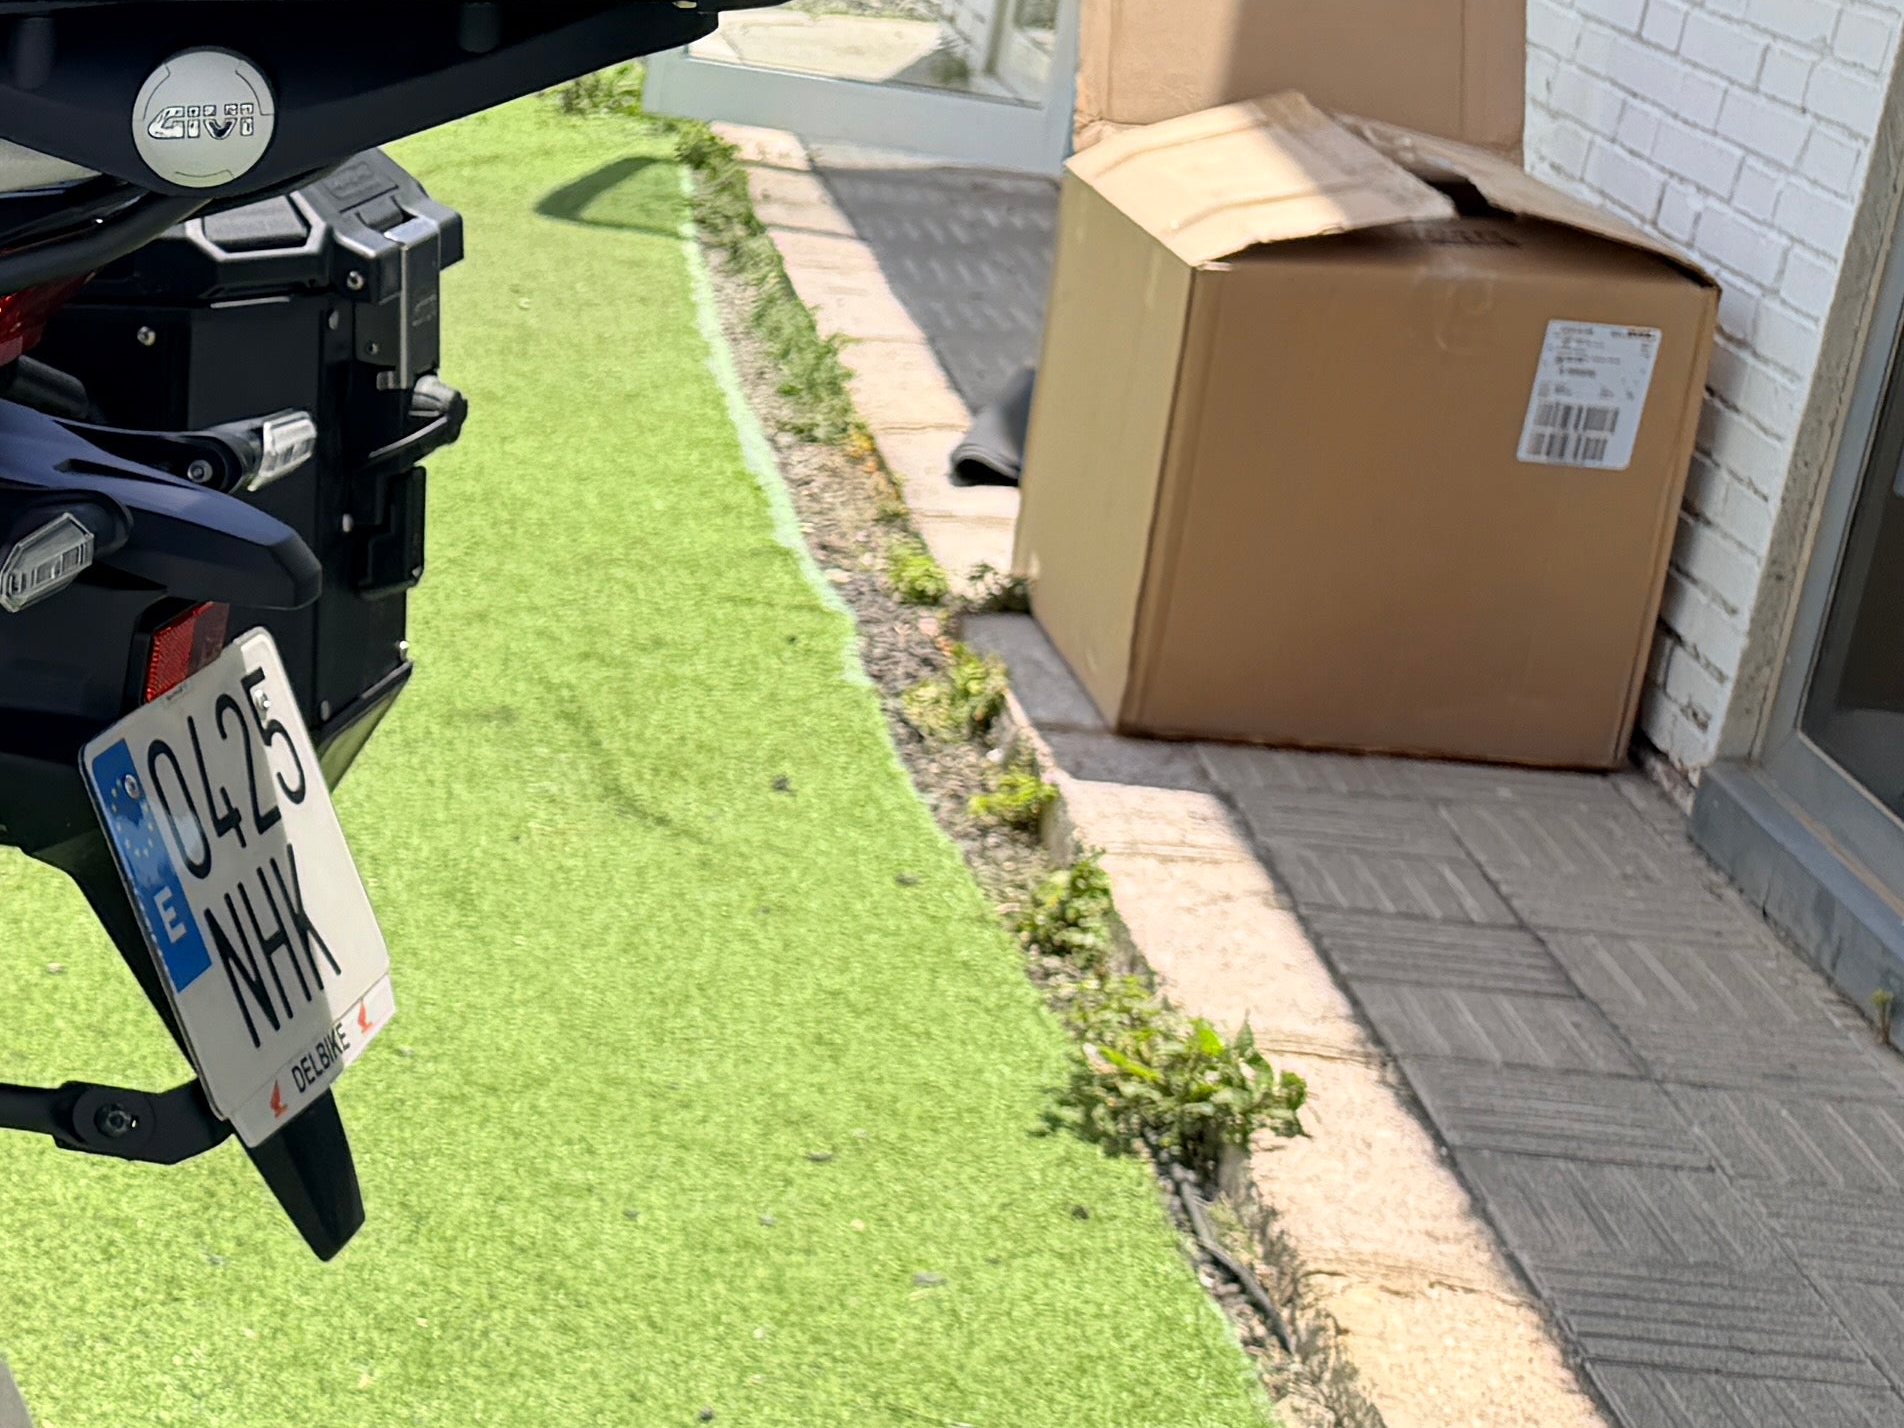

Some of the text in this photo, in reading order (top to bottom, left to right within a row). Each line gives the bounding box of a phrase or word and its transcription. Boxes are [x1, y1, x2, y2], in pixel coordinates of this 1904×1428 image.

[147, 102, 255, 141] GIVI
[147, 666, 307, 880] 0425
[154, 884, 186, 944] E
[204, 842, 342, 1049] NHK
[291, 1021, 351, 1094] DELBIKE
